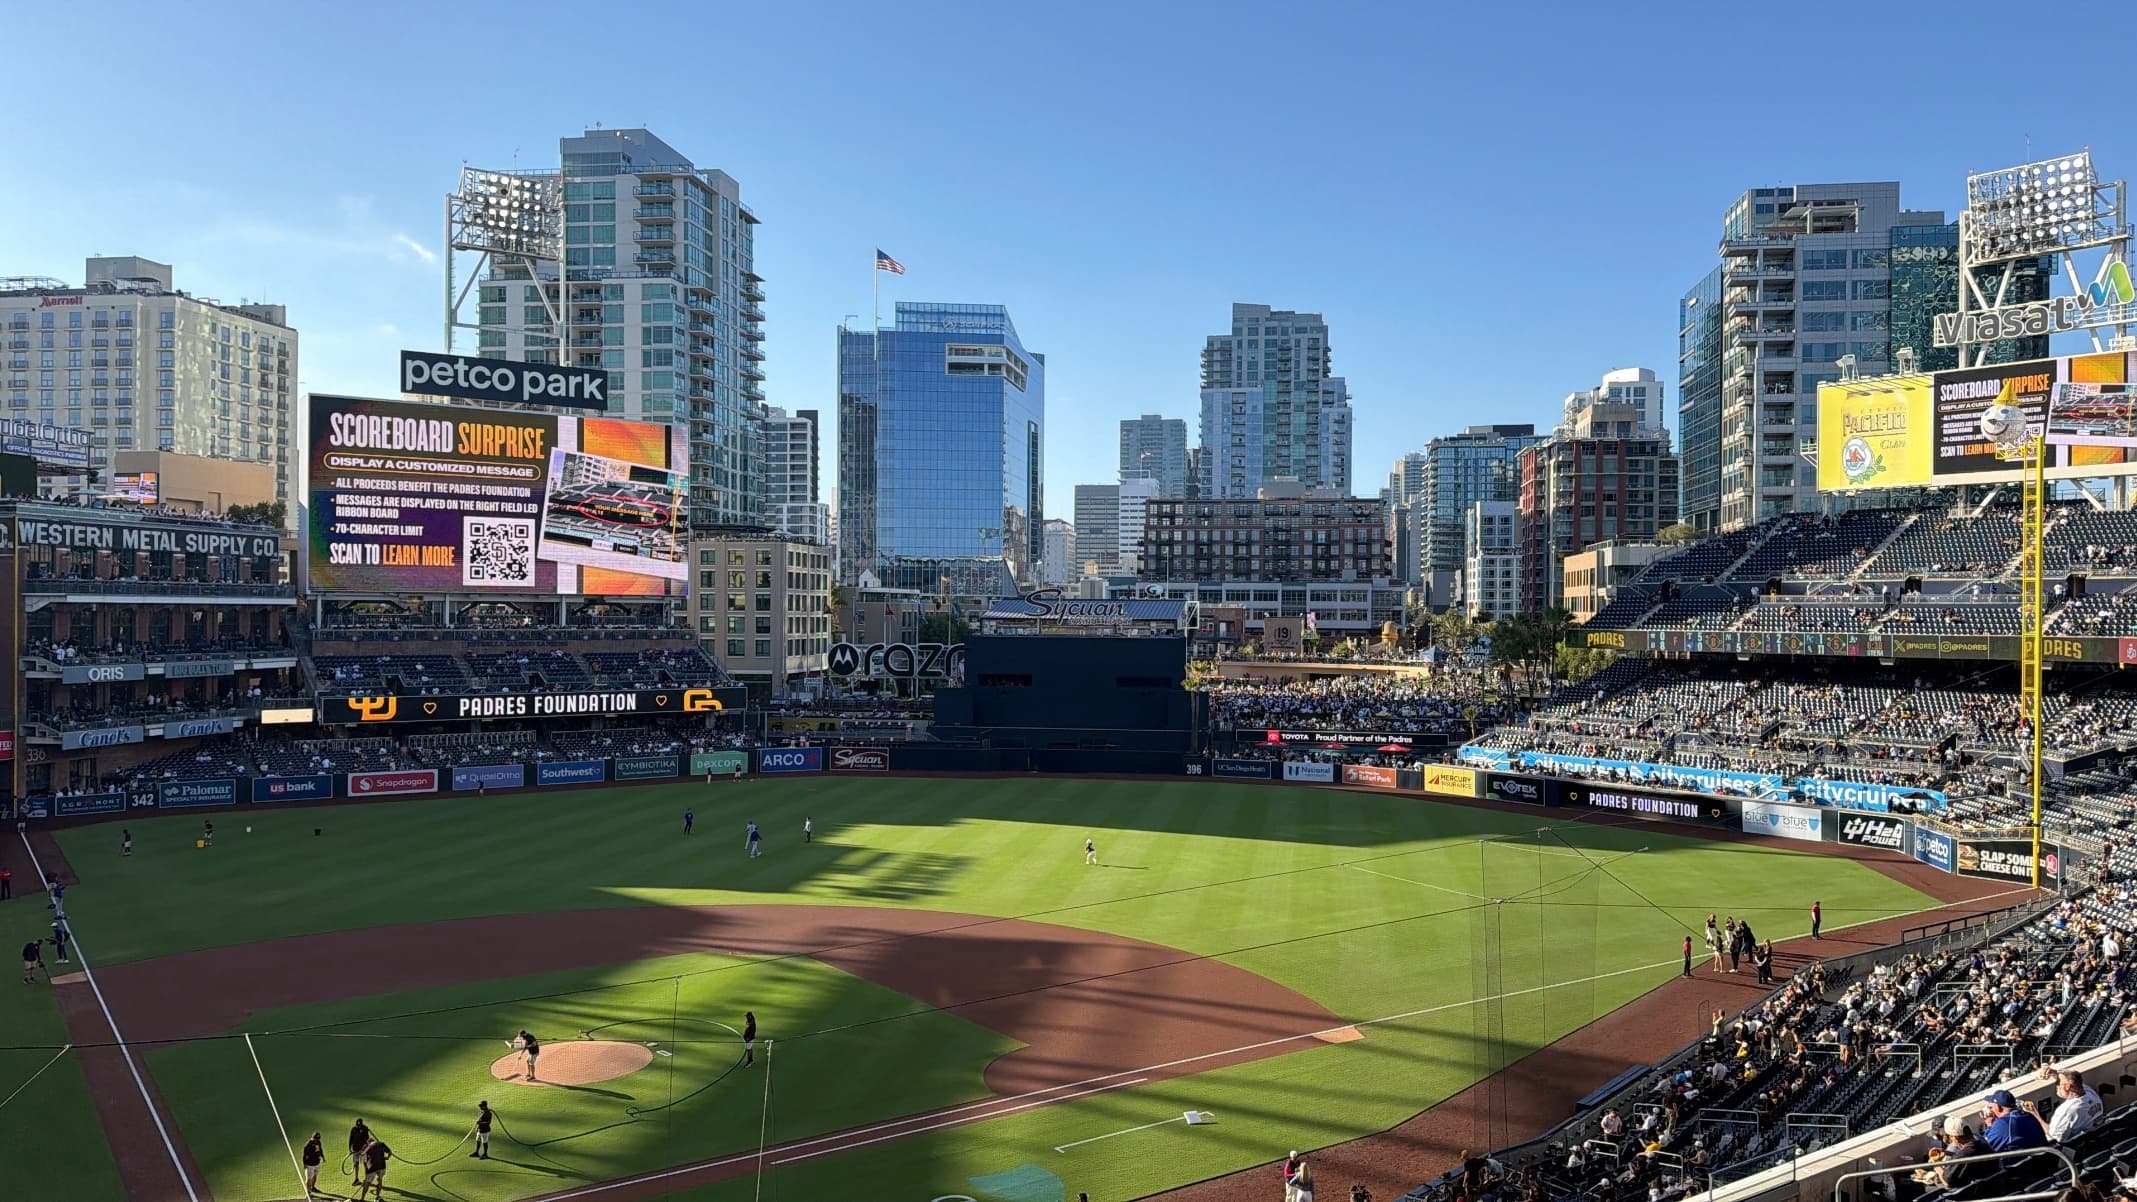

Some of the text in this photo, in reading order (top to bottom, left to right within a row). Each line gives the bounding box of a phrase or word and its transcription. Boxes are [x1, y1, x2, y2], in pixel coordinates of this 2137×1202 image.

[1937, 297, 2073, 345] Viasat
[405, 357, 604, 400] petco park
[1940, 379, 2000, 401] SCOREBOARD
[330, 412, 545, 459] SCOREBOARD SURPRISE
[1940, 446, 1956, 457] SCAN
[1956, 445, 1964, 456] TO
[1964, 444, 1984, 455] LEARN
[330, 456, 534, 477] DISPLAY A CUSTOMIZED MESSAGE
[336, 478, 531, 497] ALL PROCEEDS BENEFIT THE PADRES FOUNDATION
[336, 494, 538, 513] MESSAGES ARE DISPLAYED ON THE RIGHT FIELD LED
[335, 506, 399, 519] RIBBON BOARD
[335, 523, 424, 536] 70-CHARACTER LIMIT
[19, 521, 113, 548] WESTERN
[123, 529, 181, 552] METAL
[185, 533, 247, 555] SUPPLY
[252, 538, 278, 557] CO.
[330, 543, 455, 567] SCAN TO LEARN MORE
[1024, 588, 1126, 625] Sycuan
[1277, 627, 1289, 638] 19
[1587, 632, 1625, 648] PADRES
[2025, 639, 2082, 659] PDRES
[864, 643, 966, 677] razr
[88, 667, 124, 681] ORIS
[459, 693, 637, 716] PADRES FOUNDATION
[1281, 733, 1413, 744] TOYOTA Proud Partner of the Padres
[763, 753, 804, 766] ARCO
[834, 749, 882, 768] Sycuan
[542, 767, 593, 778] Southwest
[1186, 764, 1202, 775] 396
[1301, 766, 1331, 774] National
[182, 785, 232, 796] Palomar
[270, 781, 316, 792] us bank
[376, 778, 428, 787] Snapdragon
[1493, 781, 1537, 793] EVOTEK
[132, 794, 154, 807] 342
[1589, 792, 1698, 818] PADRES FOUNDATION
[1926, 836, 1948, 858] petco
[1980, 850, 2006, 862] SLAP
[2008, 853, 2033, 867] SOME
[1981, 863, 2011, 874] CHEESE
[2012, 866, 2026, 876] ON
